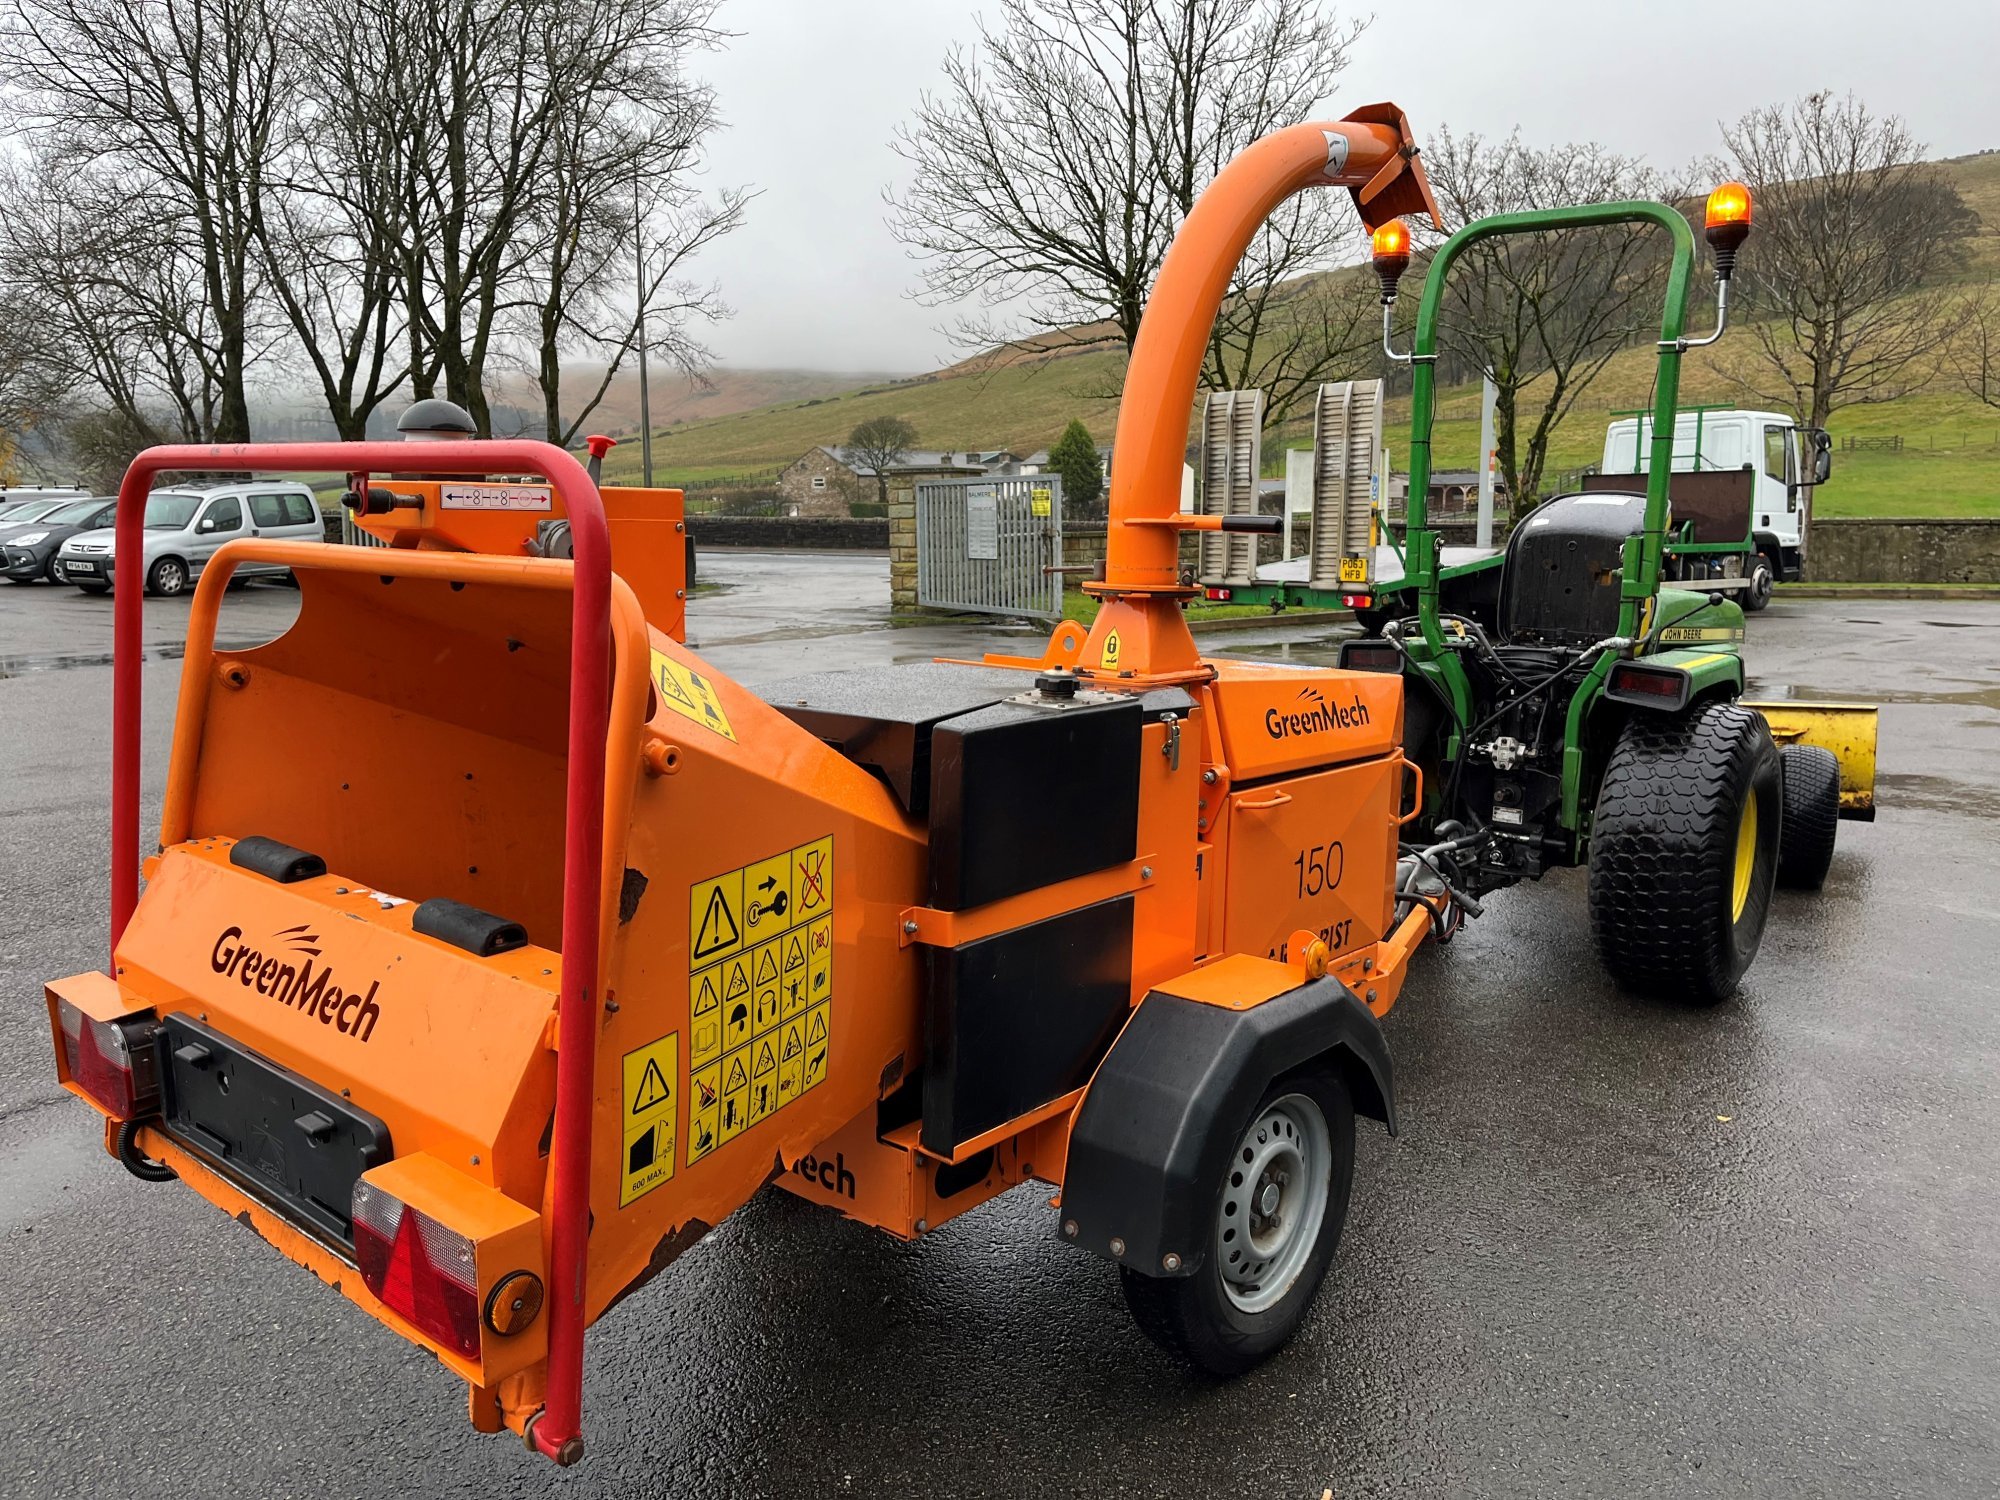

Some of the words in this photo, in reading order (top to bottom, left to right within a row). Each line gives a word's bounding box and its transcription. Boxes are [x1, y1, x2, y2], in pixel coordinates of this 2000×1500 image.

[1344, 569, 1361, 579] HFB
[1664, 629, 1681, 640] JOHN
[1683, 628, 1702, 639] DEERE
[1265, 695, 1370, 739] GreenMech
[1294, 841, 1344, 899] 150
[211, 926, 380, 1043] GreenMech
[632, 1177, 646, 1191] 600
